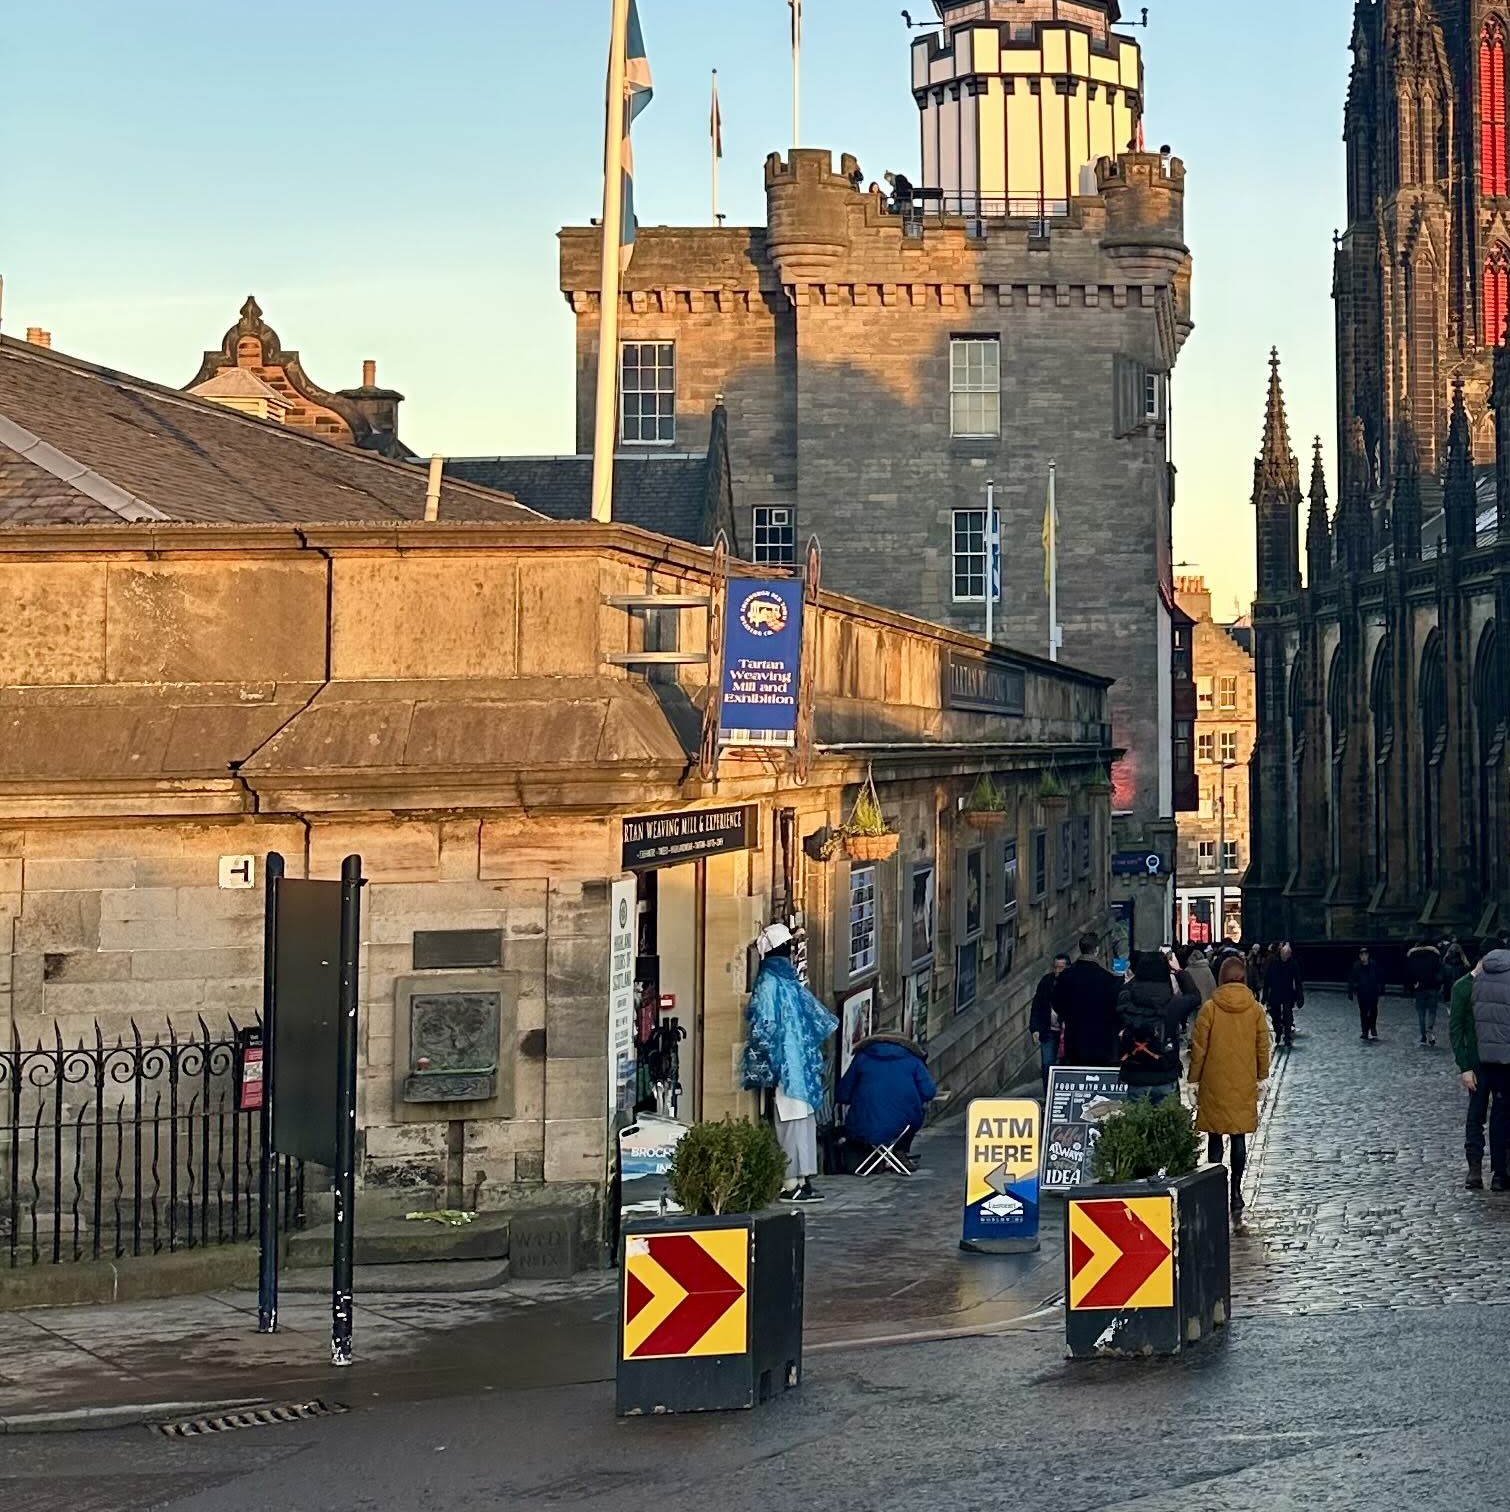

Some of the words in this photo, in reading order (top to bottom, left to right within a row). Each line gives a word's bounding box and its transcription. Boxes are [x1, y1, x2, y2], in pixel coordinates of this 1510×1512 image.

[738, 658, 785, 670] Tartan
[729, 670, 792, 684] Weaving
[732, 681, 756, 692] Mill
[759, 681, 788, 693] and
[724, 693, 795, 705] Exhibition
[645, 817, 680, 840] WEAVING
[681, 815, 698, 835] MILL
[705, 811, 742, 832] EXPERIENCE
[975, 1118, 1033, 1139] ATM
[631, 1147, 674, 1158] BROCH
[974, 1144, 1033, 1163] HERE
[1049, 1141, 1085, 1162] ALWAYS
[1045, 1169, 1081, 1185] IDEA
